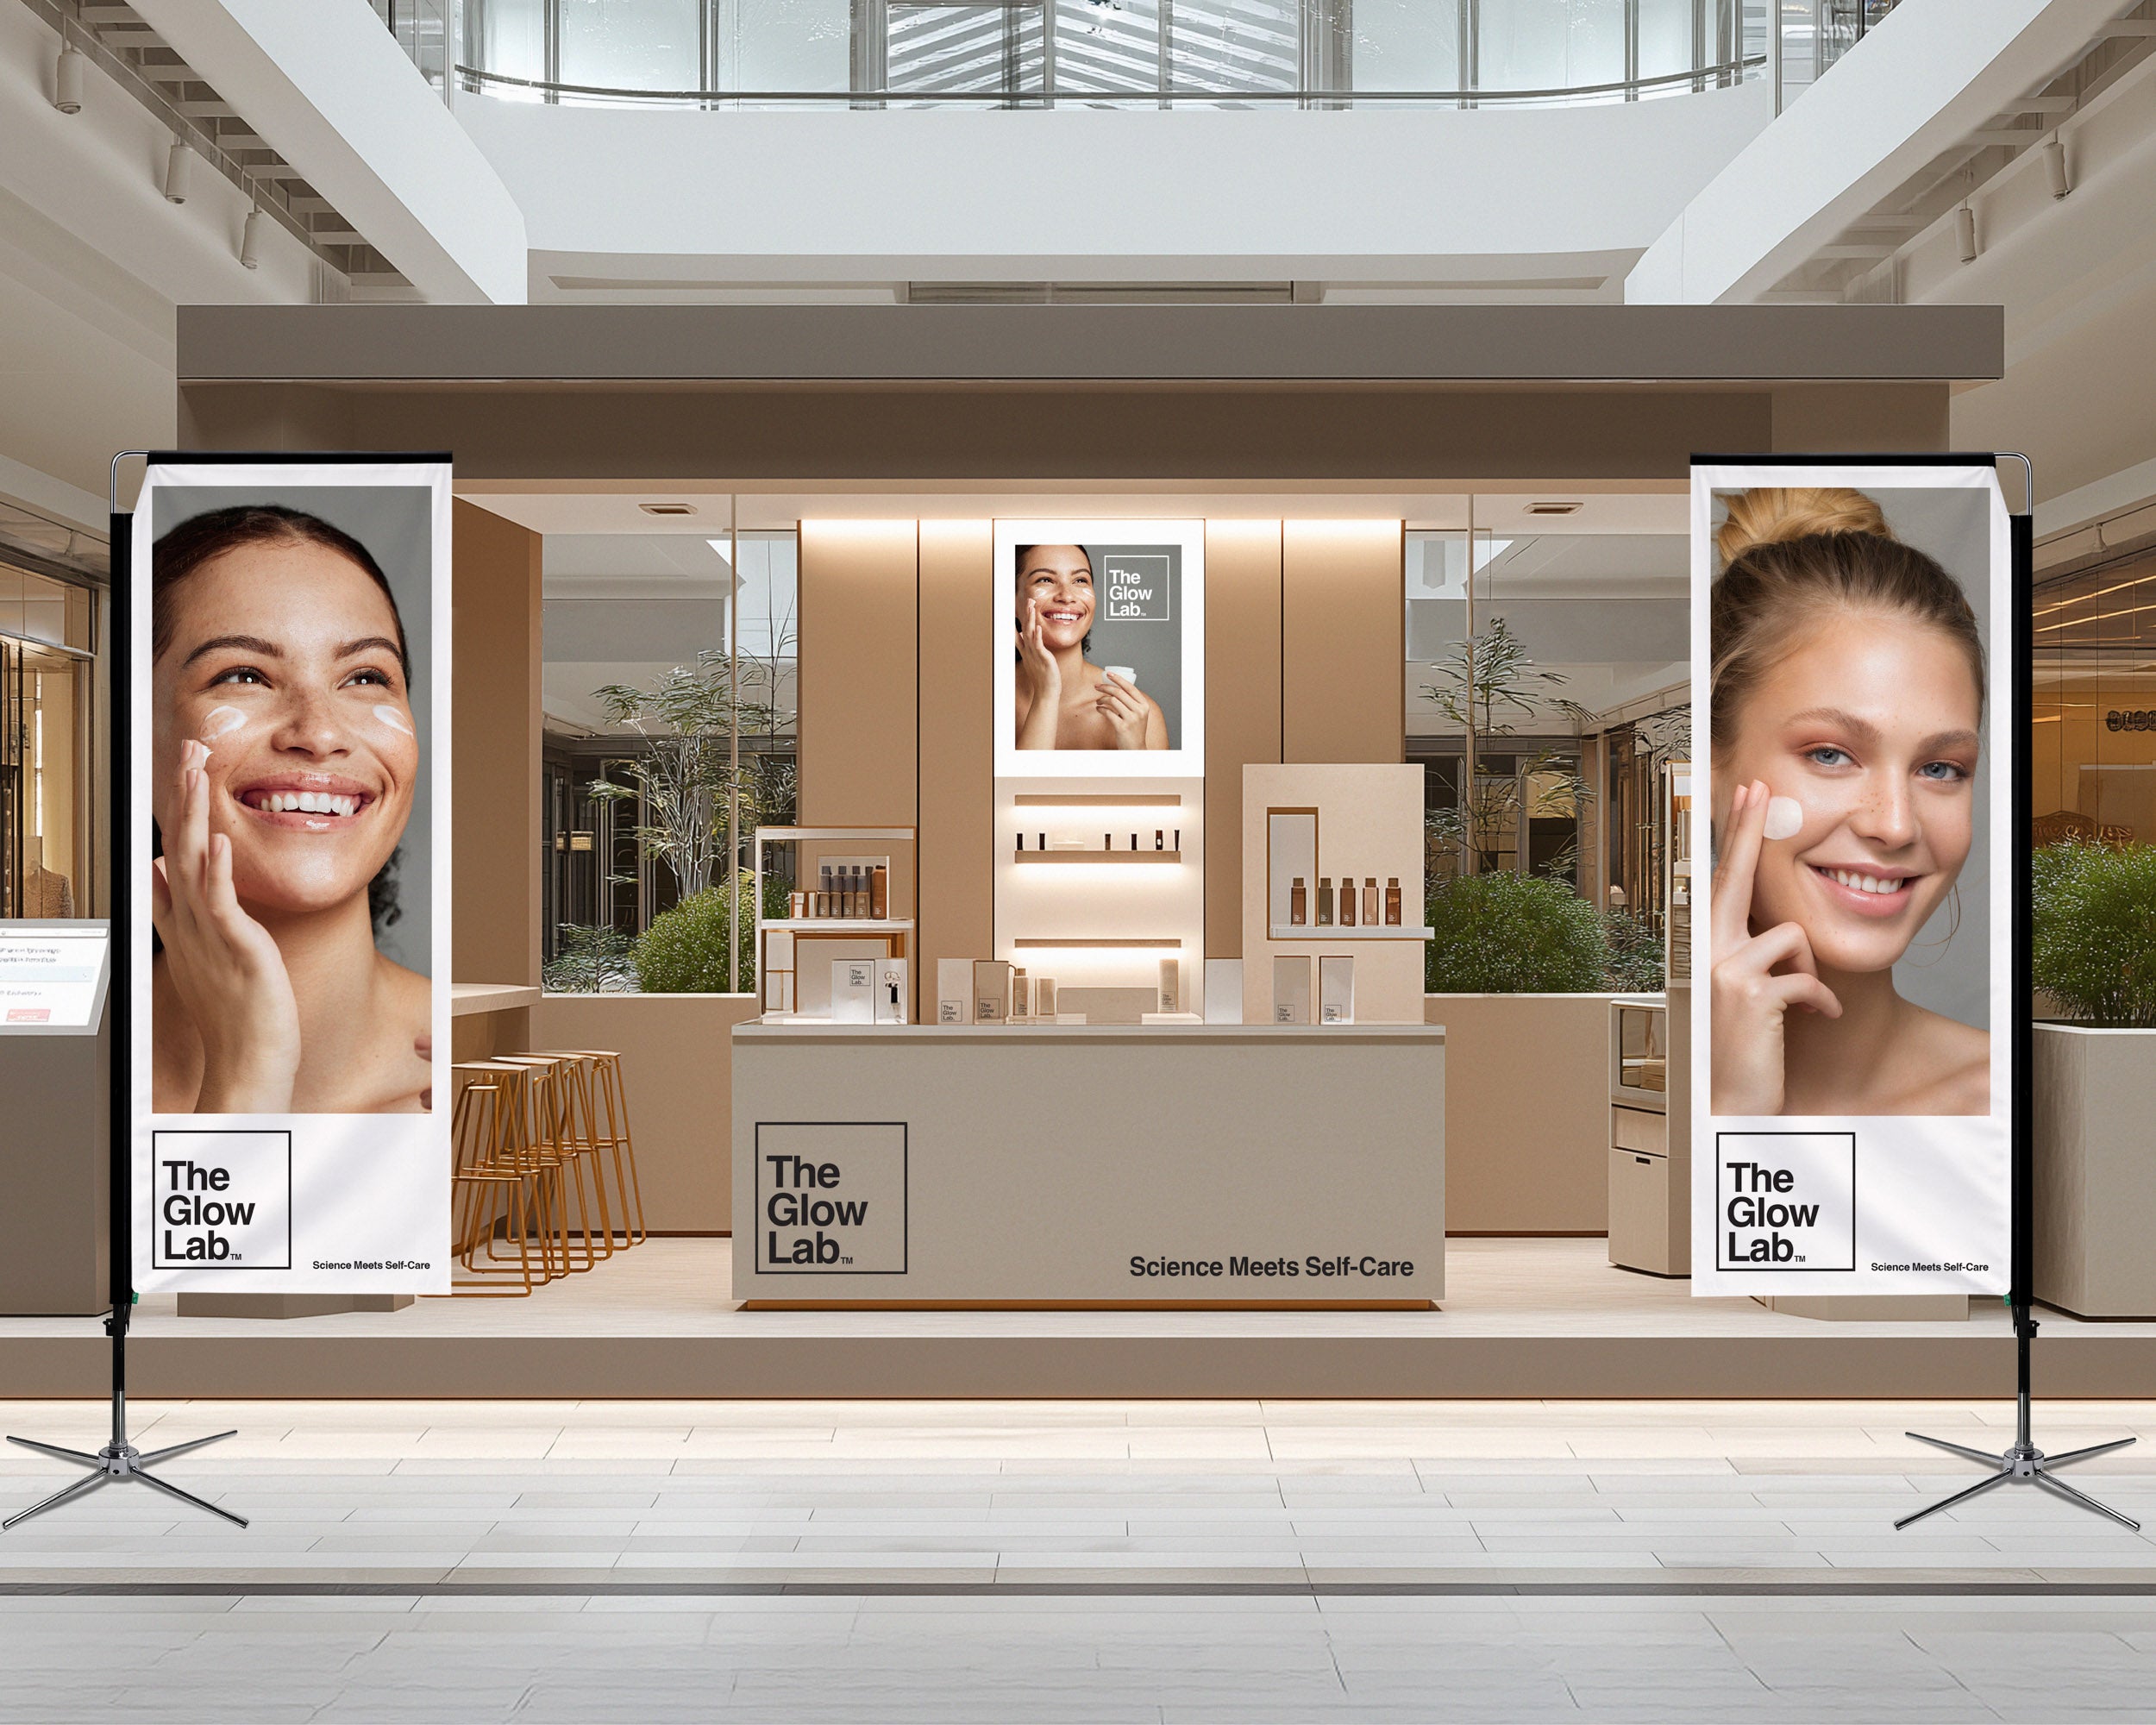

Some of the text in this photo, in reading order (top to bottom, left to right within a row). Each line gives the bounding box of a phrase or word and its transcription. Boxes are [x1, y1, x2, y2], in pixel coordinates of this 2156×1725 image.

[1109, 569, 1141, 584] The
[1109, 585, 1153, 600] Glow
[163, 1161, 230, 1191] The
[767, 1156, 840, 1189] The
[1727, 1163, 1794, 1193] The
[163, 1195, 255, 1226] Glow
[767, 1193, 868, 1227] Glow
[1727, 1196, 1820, 1228] Glow
[312, 1260, 430, 1270] Science Meets Self-Care
[1130, 1256, 1413, 1276] Science Meets Self-Care
[1871, 1262, 1989, 1271] Science Meets Self-Care
